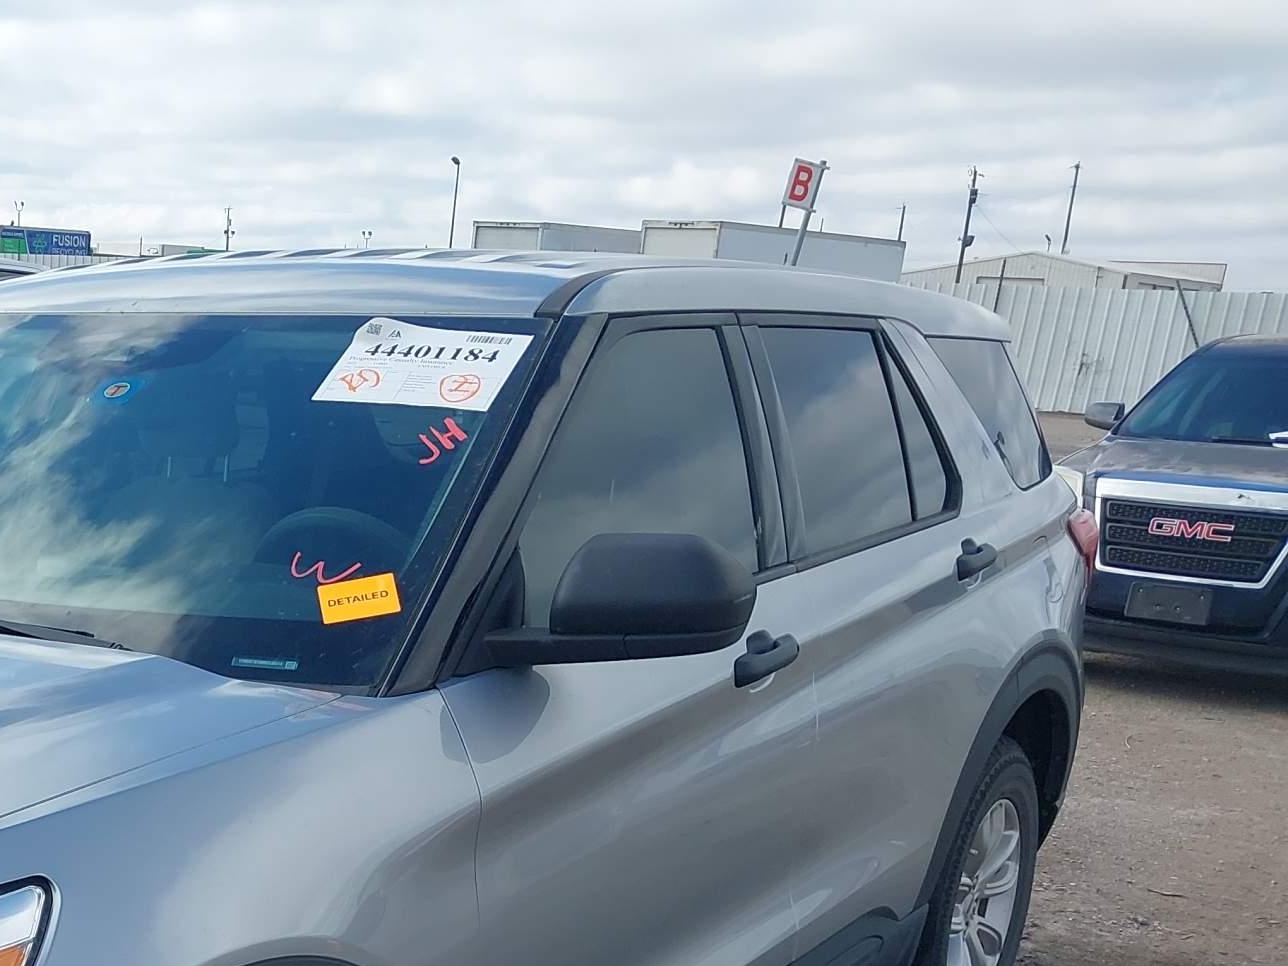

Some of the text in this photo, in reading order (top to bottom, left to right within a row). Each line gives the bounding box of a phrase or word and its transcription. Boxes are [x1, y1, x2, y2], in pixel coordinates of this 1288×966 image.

[788, 165, 813, 202] B
[52, 234, 87, 248] FUSION
[365, 343, 498, 364] 44401184
[1148, 517, 1236, 543] GMC
[327, 589, 390, 608] DETAILED
